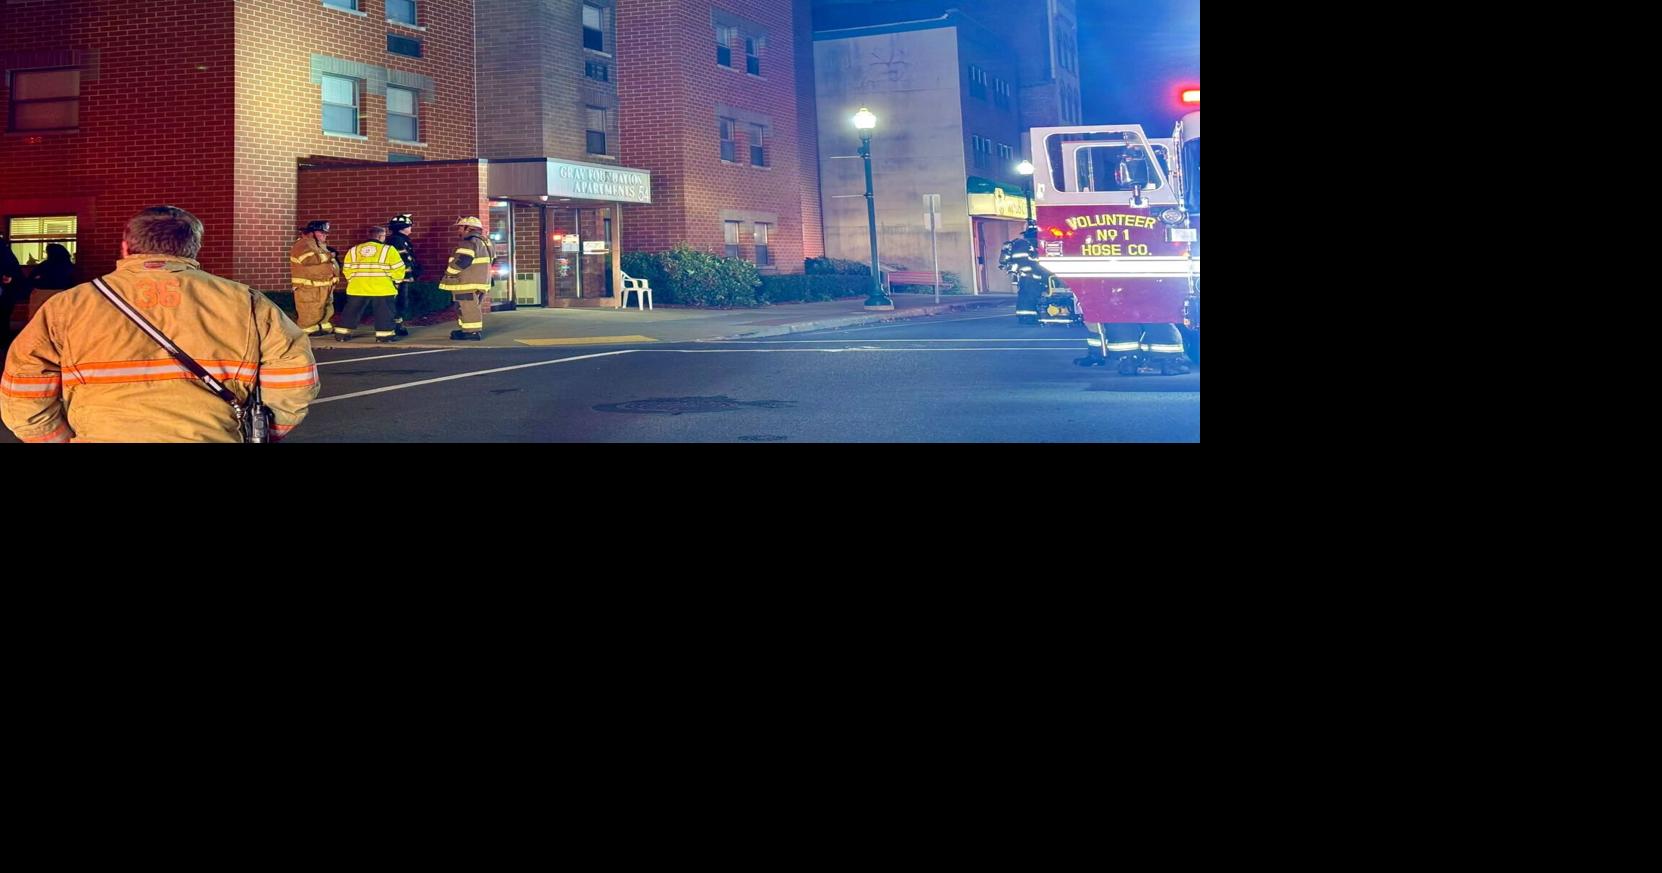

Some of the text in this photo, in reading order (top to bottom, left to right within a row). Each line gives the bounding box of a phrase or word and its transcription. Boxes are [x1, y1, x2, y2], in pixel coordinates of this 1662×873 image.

[560, 166, 642, 184] GRAY FOUNDATION
[574, 181, 635, 198] APARTMENTS
[1066, 214, 1156, 230] VOLUNTEER
[1122, 229, 1130, 241] 1
[1081, 244, 1153, 256] HOSE CO.
[134, 278, 181, 308] 36
